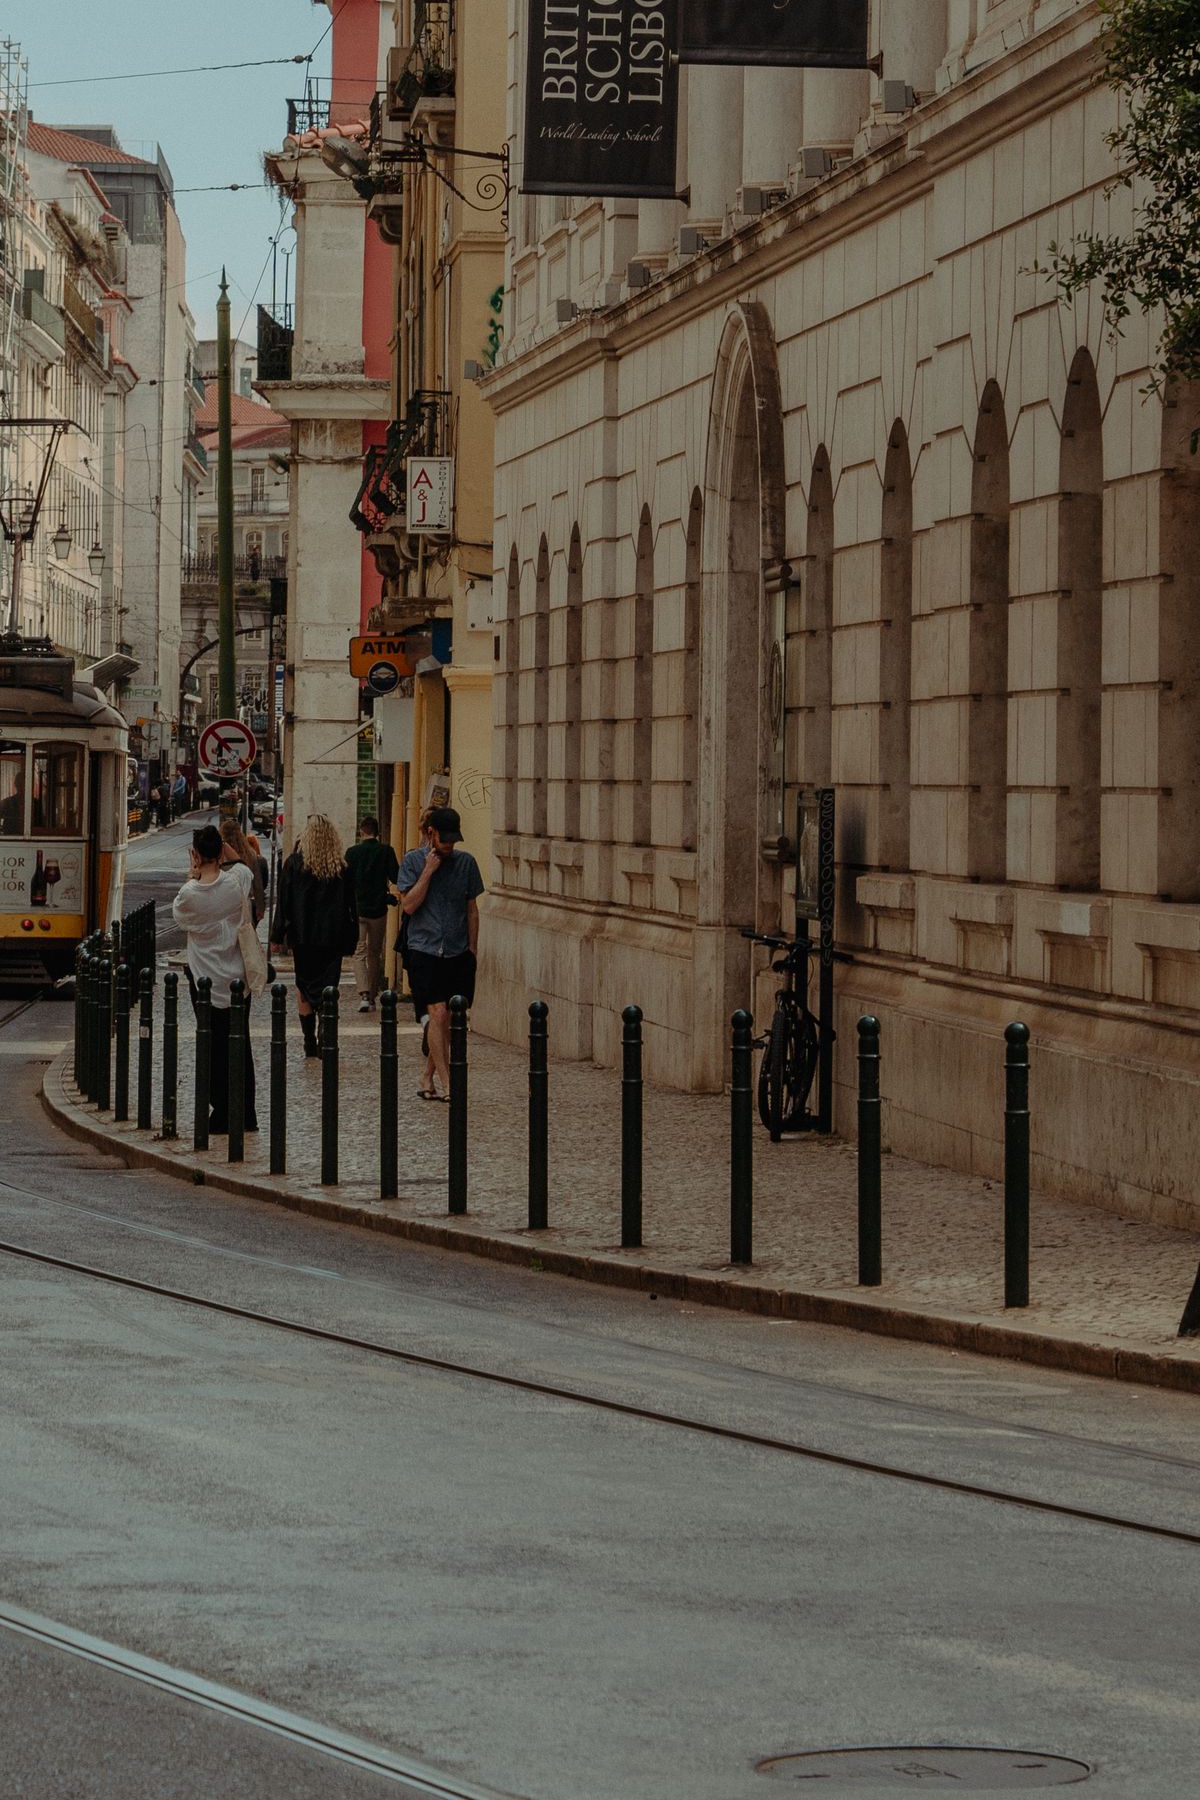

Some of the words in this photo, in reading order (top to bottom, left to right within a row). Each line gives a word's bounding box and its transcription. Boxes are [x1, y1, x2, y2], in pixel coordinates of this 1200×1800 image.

[538, 122, 577, 140] World
[578, 123, 620, 151] Leading
[621, 123, 663, 142] Schools
[412, 467, 433, 490] A
[417, 489, 429, 501] &
[416, 501, 426, 524] J
[361, 640, 407, 655] ATM
